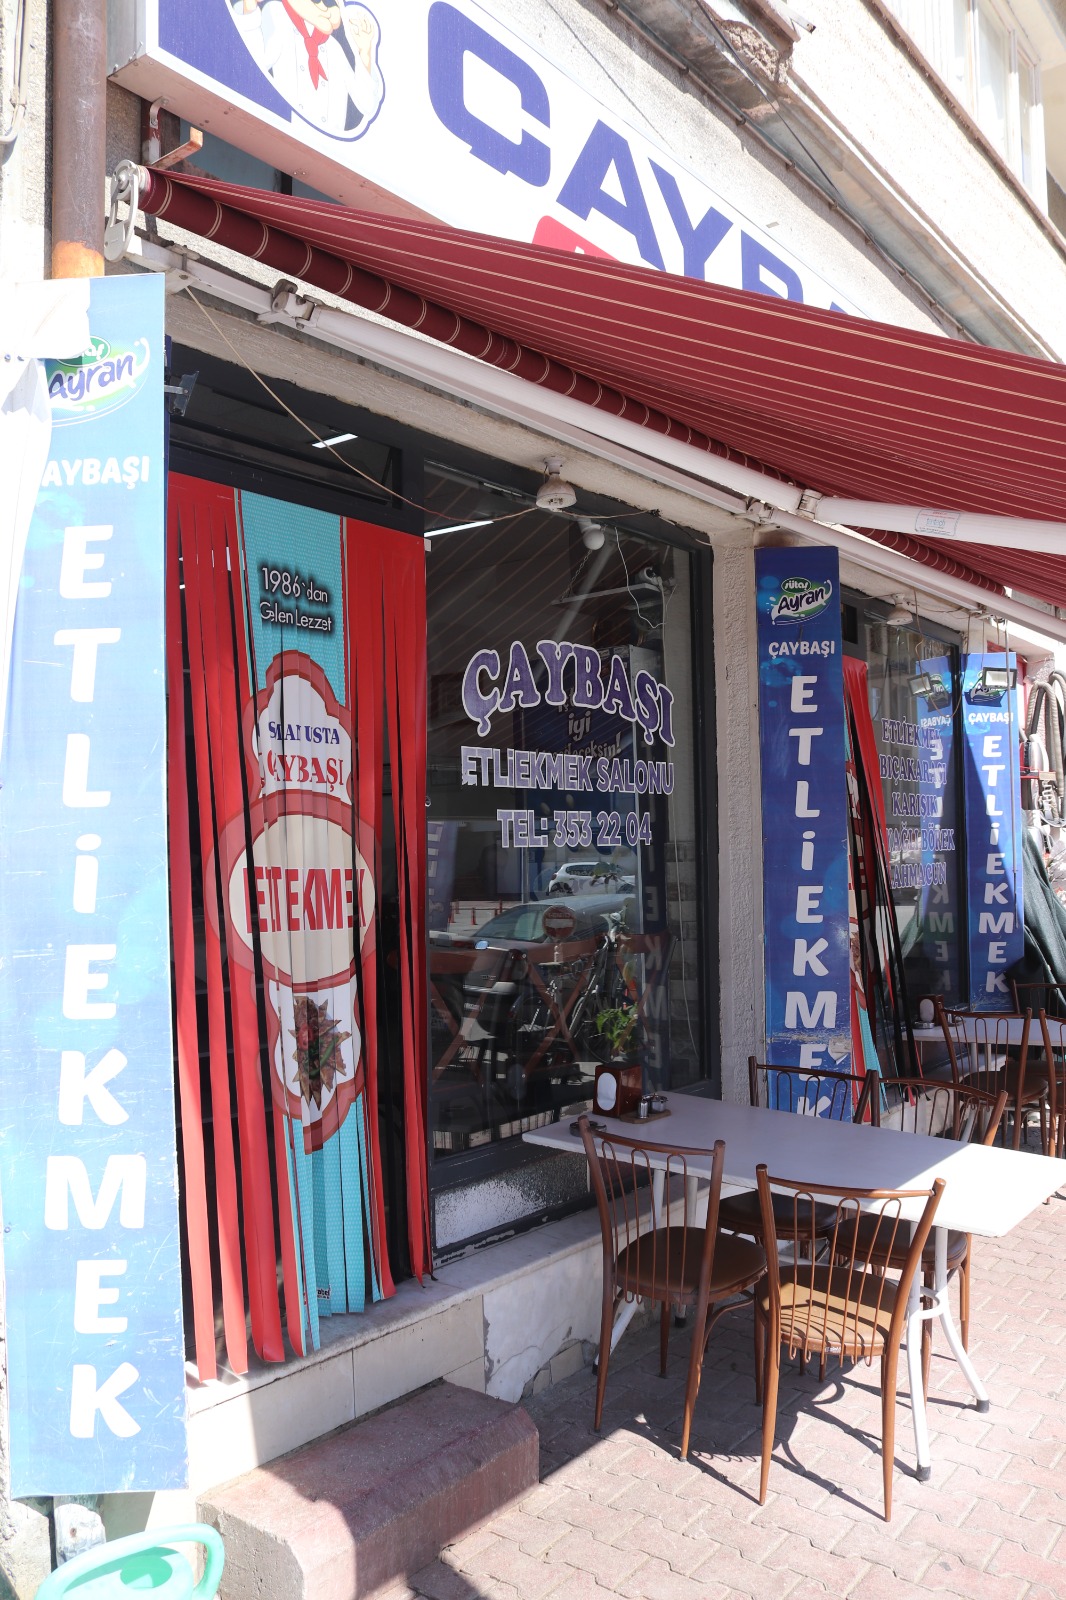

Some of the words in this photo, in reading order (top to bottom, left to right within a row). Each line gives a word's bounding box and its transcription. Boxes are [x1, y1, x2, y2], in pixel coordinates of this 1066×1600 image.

[50, 354, 133, 401] Ayran
[42, 456, 149, 489] AYBAŞI
[778, 587, 825, 614] Ayran
[260, 601, 293, 624] Gelen
[295, 608, 332, 631] Lezzet
[768, 640, 836, 660] ÇAYBAŞI
[462, 640, 675, 747] ÇAYBAŞI
[967, 711, 1014, 725] ÇAYBAŞI
[304, 725, 340, 745] USTA
[596, 757, 675, 795] SALONU
[497, 808, 549, 848] TEL:
[553, 810, 593, 848] 353
[596, 811, 622, 847] 22
[625, 811, 652, 846] 04
[921, 822, 956, 852] BÖREK
[890, 862, 947, 890] AHMACUN
